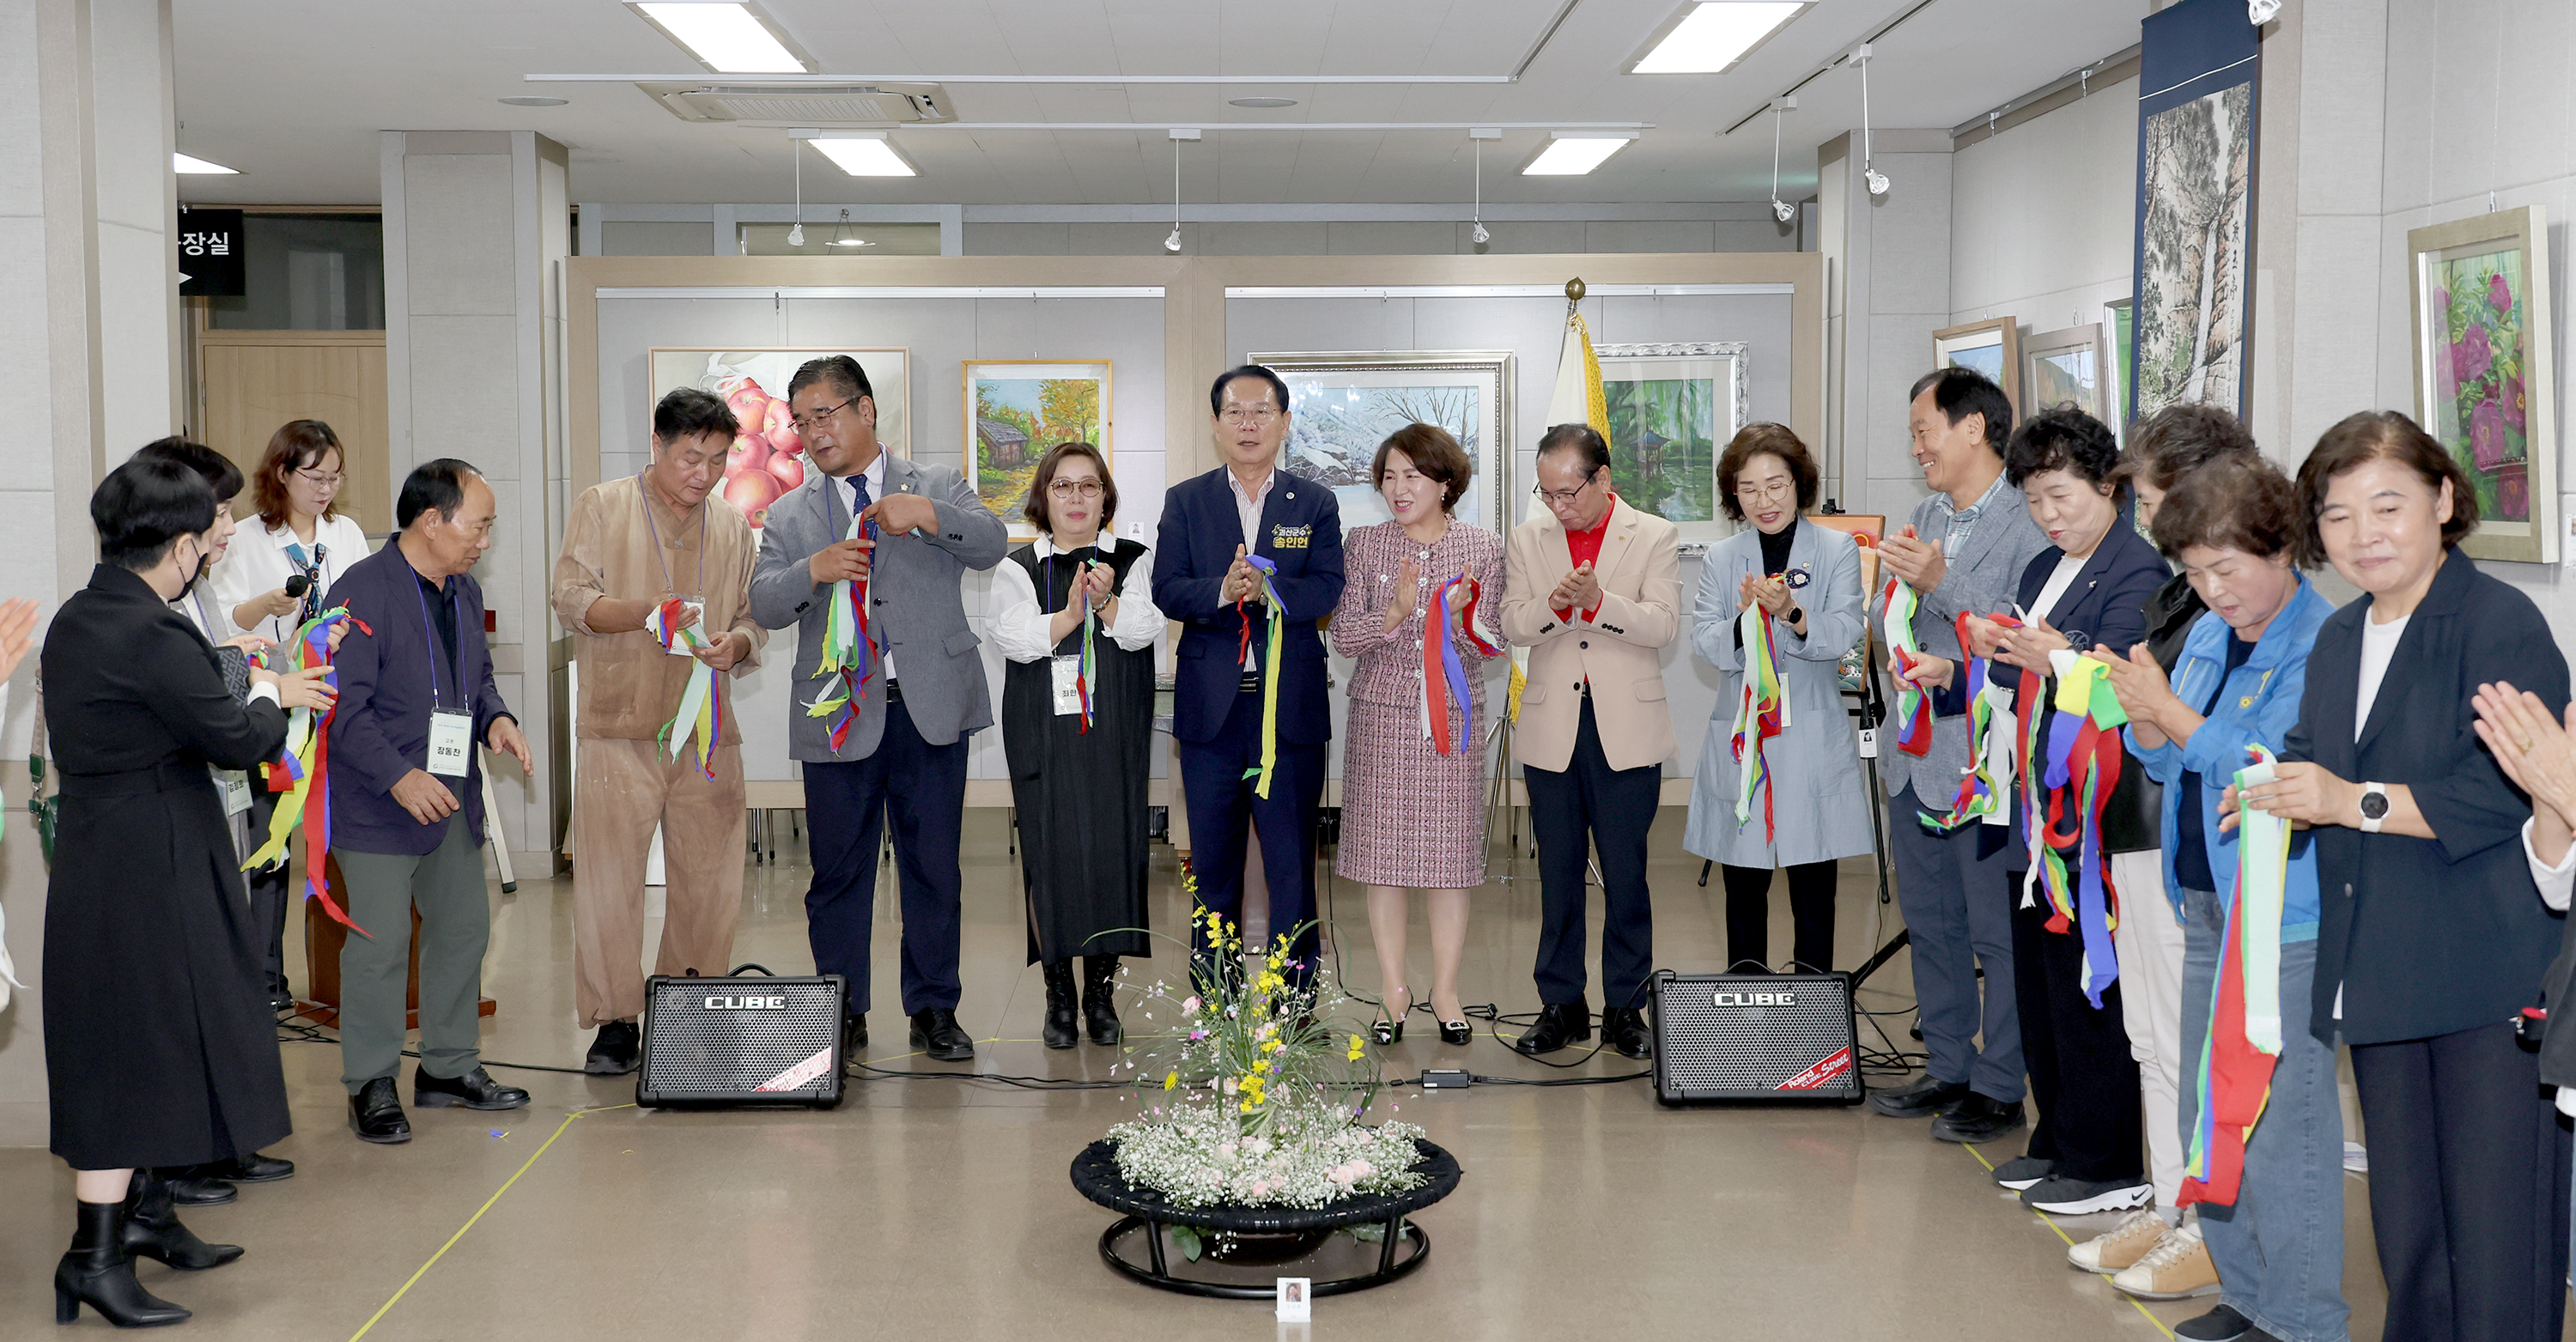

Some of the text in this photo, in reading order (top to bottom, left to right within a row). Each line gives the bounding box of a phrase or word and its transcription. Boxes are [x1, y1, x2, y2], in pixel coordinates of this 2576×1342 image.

[179, 232, 229, 255] 장실
[1275, 537, 1309, 548] 송인헌
[437, 746, 461, 756] 장동찬
[704, 996, 786, 1010] CUBE
[1714, 993, 1795, 1006] CUBE
[1821, 1053, 1850, 1077] Street
[1788, 1069, 1814, 1089] Roland
